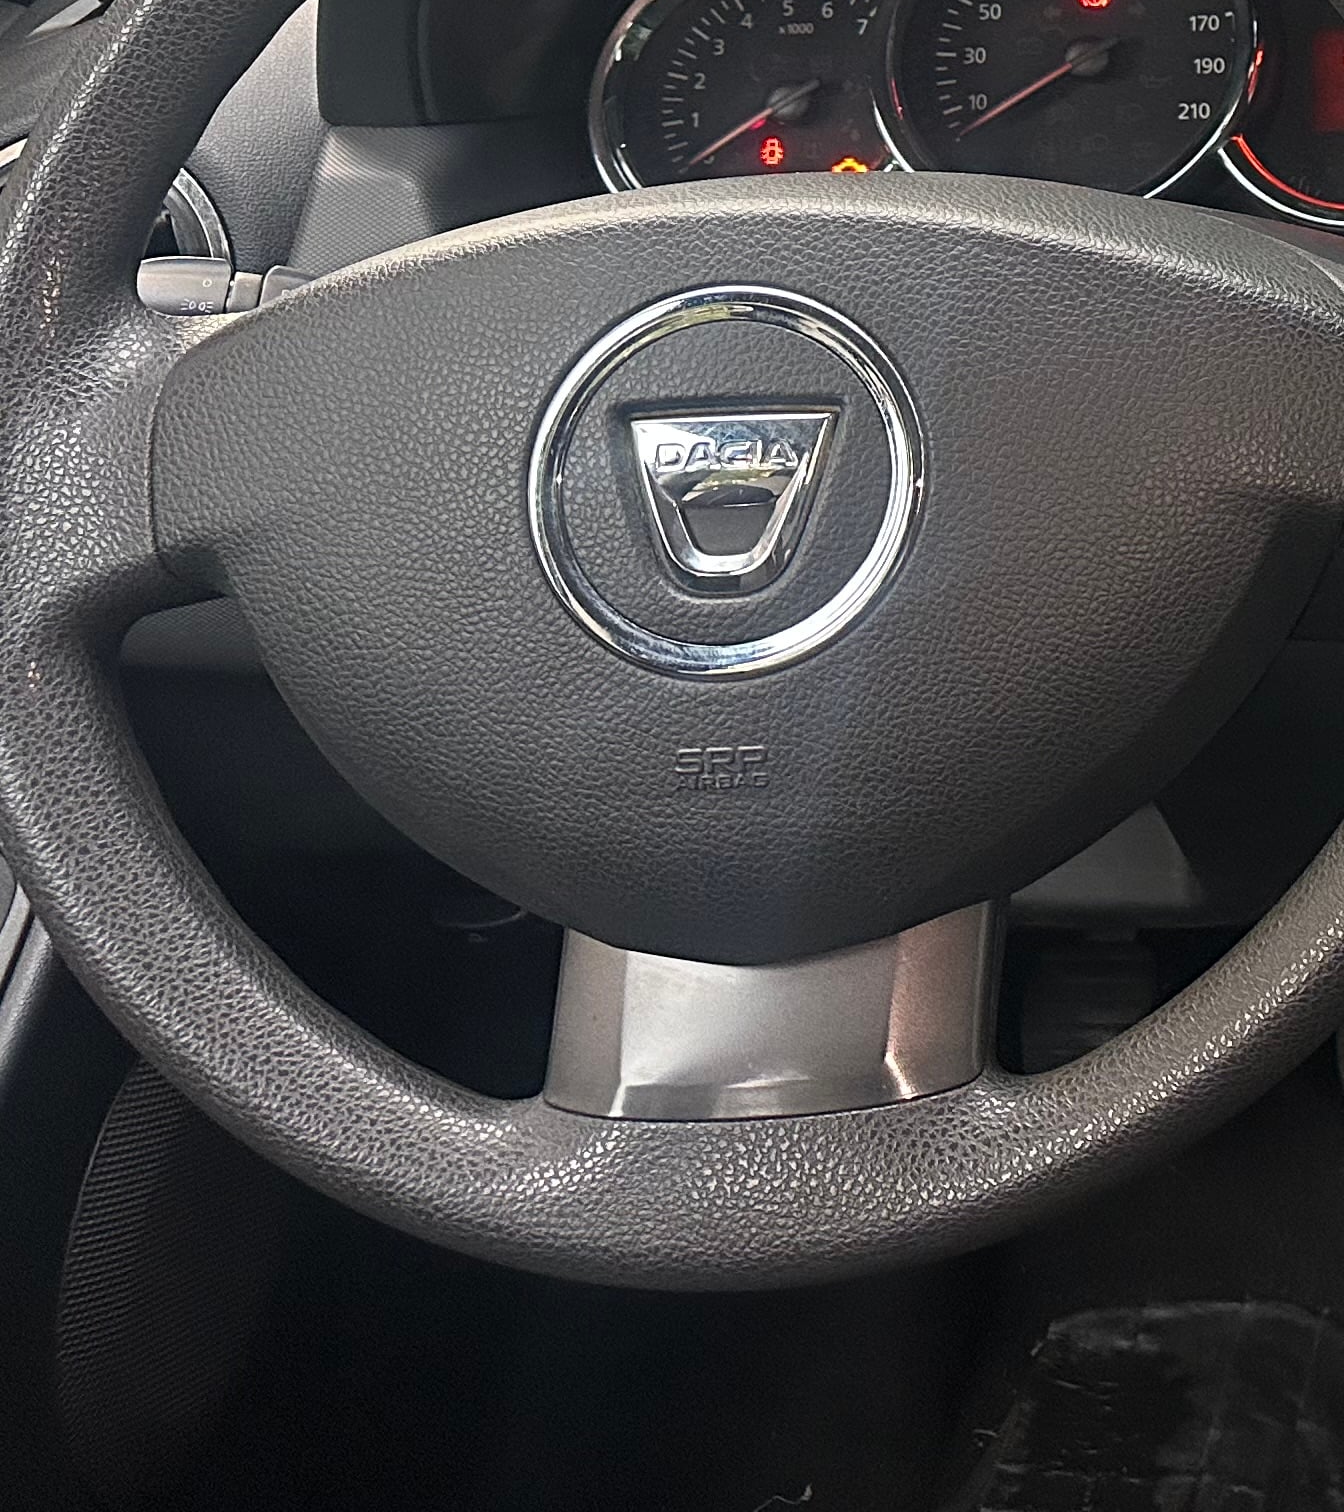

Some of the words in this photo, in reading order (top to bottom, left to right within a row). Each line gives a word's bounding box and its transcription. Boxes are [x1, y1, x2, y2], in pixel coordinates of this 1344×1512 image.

[783, 1, 794, 16] 5
[822, 2, 833, 18] 6
[979, 4, 1002, 20] 50
[740, 13, 752, 29] 4
[857, 19, 869, 35] 7
[1189, 16, 1220, 31] 170
[714, 40, 725, 55] 3
[964, 48, 987, 63] 30
[1194, 57, 1225, 74] 190
[694, 73, 706, 89] 2
[969, 94, 987, 110] 10
[1177, 103, 1211, 120] 210
[691, 112, 699, 128] 1
[655, 440, 799, 472] DACIA
[675, 745, 768, 774] SRP
